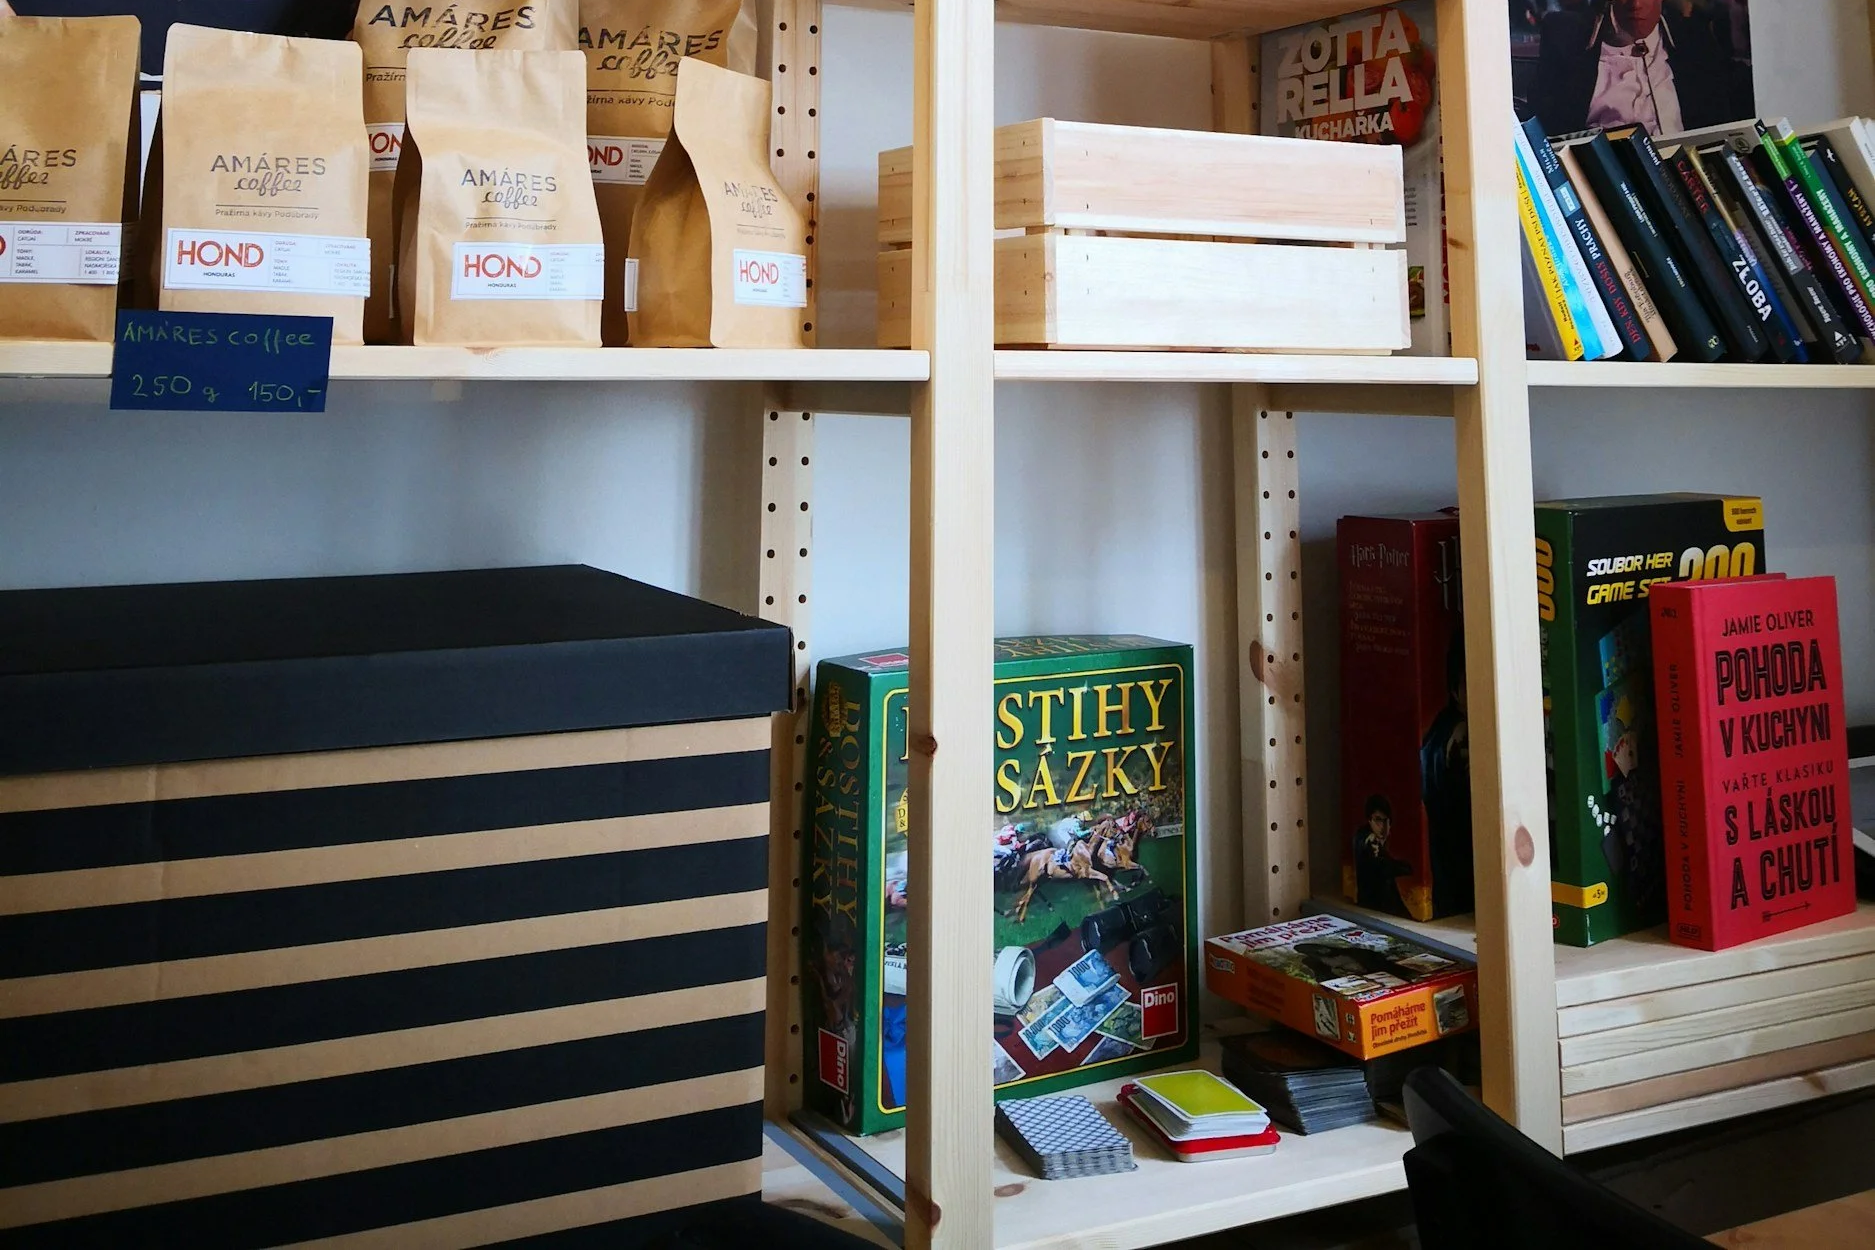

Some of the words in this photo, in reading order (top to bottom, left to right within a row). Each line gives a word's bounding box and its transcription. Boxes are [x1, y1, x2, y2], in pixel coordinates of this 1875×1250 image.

[368, 4, 537, 33] AMÁRES
[579, 25, 724, 57] AMÁRES
[1278, 9, 1412, 79] ZOTTA
[366, 71, 406, 82] Pražírn
[1278, 55, 1414, 125] RELLA
[1294, 110, 1395, 141] KUCHAŘKA
[0, 163, 50, 191] ffee
[211, 153, 326, 176] AMÁRES
[234, 172, 302, 197] coffee
[461, 167, 558, 193] AMÁRES
[481, 186, 539, 210] coffee
[177, 239, 265, 268] HOND
[1574, 218, 1601, 260] PRACHY
[464, 253, 543, 279] HOND
[739, 259, 780, 285] HOND
[1821, 240, 1844, 280] EKONOMY
[1613, 296, 1629, 318] KDY
[132, 373, 193, 398] 250
[202, 385, 220, 403] g
[1378, 542, 1411, 569] Potter
[1587, 554, 1643, 577] SOUBOR
[1645, 551, 1674, 570] HER
[1586, 580, 1636, 606] GAME
[1722, 615, 1763, 637] JAMIE
[1766, 609, 1815, 632] OLIVER
[1715, 638, 1827, 706] POHODA
[1669, 664, 1681, 712] OLIVER
[995, 678, 1174, 750] STIHY
[1672, 718, 1684, 759] JAMIE
[1719, 717, 1735, 758] V
[1741, 702, 1831, 755] KUCHYNI
[994, 741, 1176, 813] SÁZKY
[1722, 772, 1768, 794] VAŘTE
[1776, 760, 1834, 784] KLASIKU
[835, 700, 861, 929] DOSTIHY
[1725, 805, 1739, 846] S
[1748, 784, 1837, 841] LÁSKOU
[1731, 856, 1750, 910] A
[1760, 821, 1840, 901] CHUTÍ
[1681, 856, 1692, 911] POHODA
[1219, 916, 1332, 944] Pomáháme
[1144, 991, 1175, 1009] Dino
[1370, 1002, 1426, 1025] Pomáháme
[1389, 1014, 1418, 1036] přežít
[836, 1039, 847, 1088] Dino
